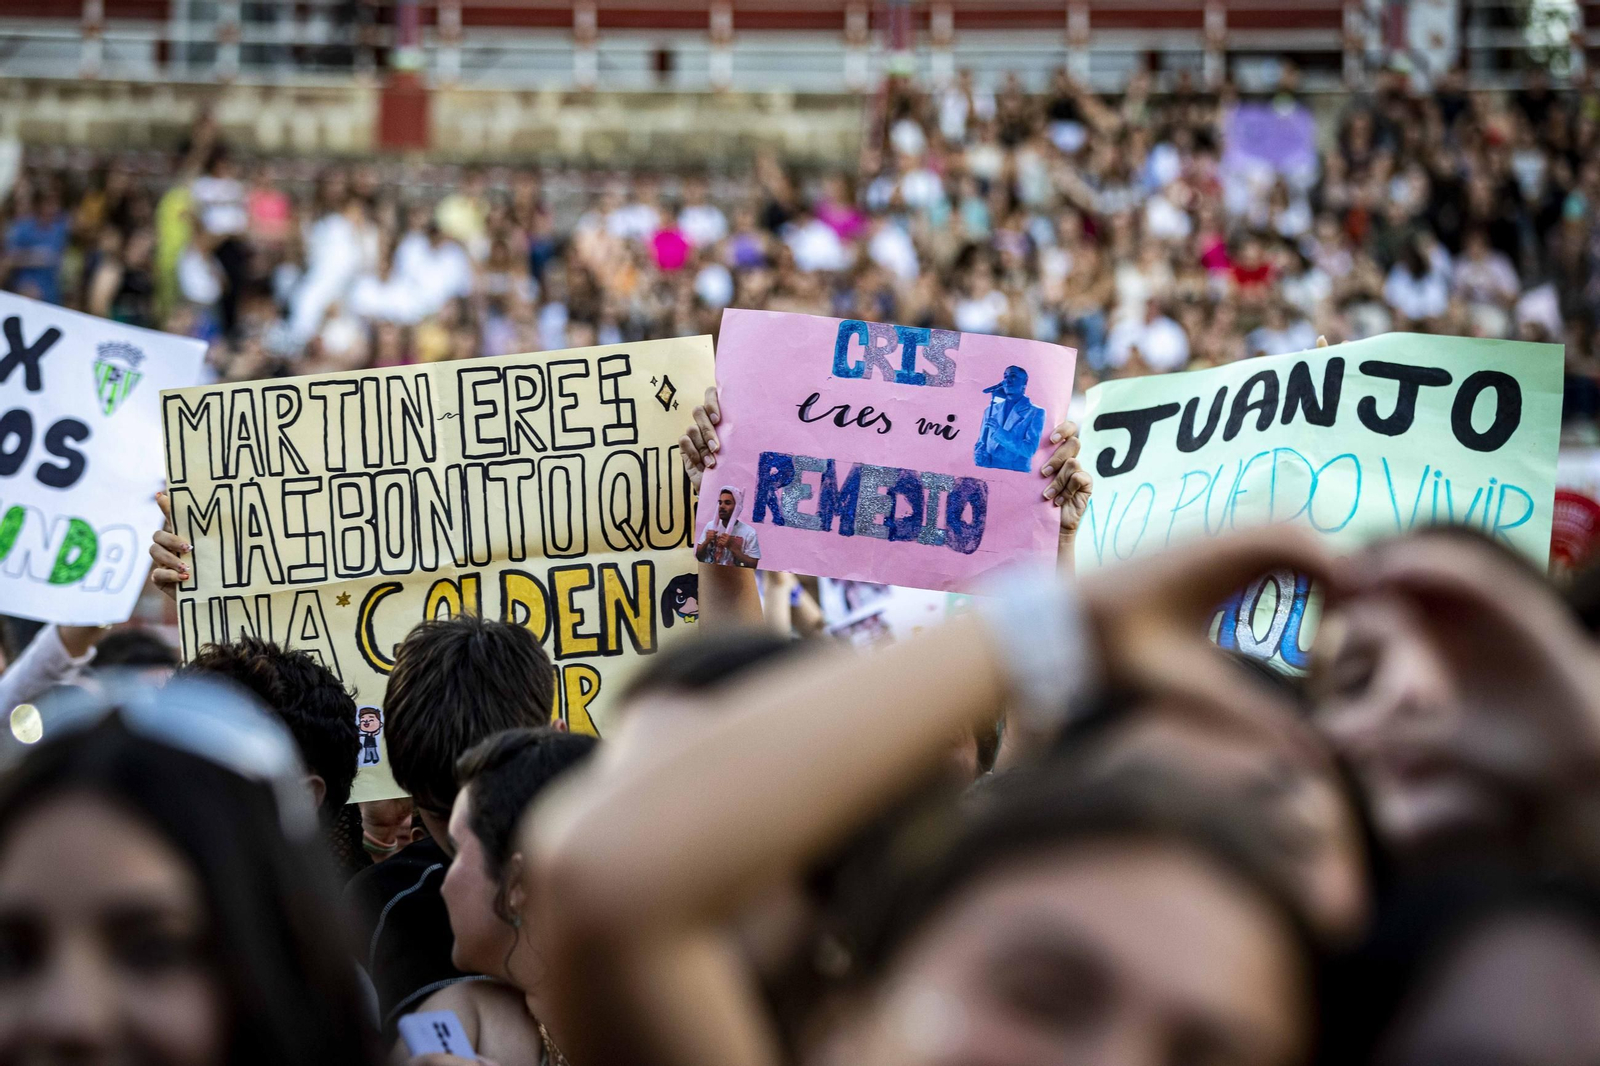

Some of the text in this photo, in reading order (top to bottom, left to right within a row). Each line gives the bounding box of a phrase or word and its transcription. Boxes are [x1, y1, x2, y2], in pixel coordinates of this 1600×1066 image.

[0, 316, 63, 392] X
[831, 319, 962, 388] CRIS
[163, 354, 639, 484] MARTIN ERES
[796, 392, 960, 441] eres mi
[1093, 356, 1523, 478] JUANJO
[329, 453, 588, 578] BONITO
[601, 444, 697, 551] QU
[752, 451, 989, 555] REMEDIO
[1073, 483, 1155, 566] NO
[1165, 447, 1362, 546] PUEDO
